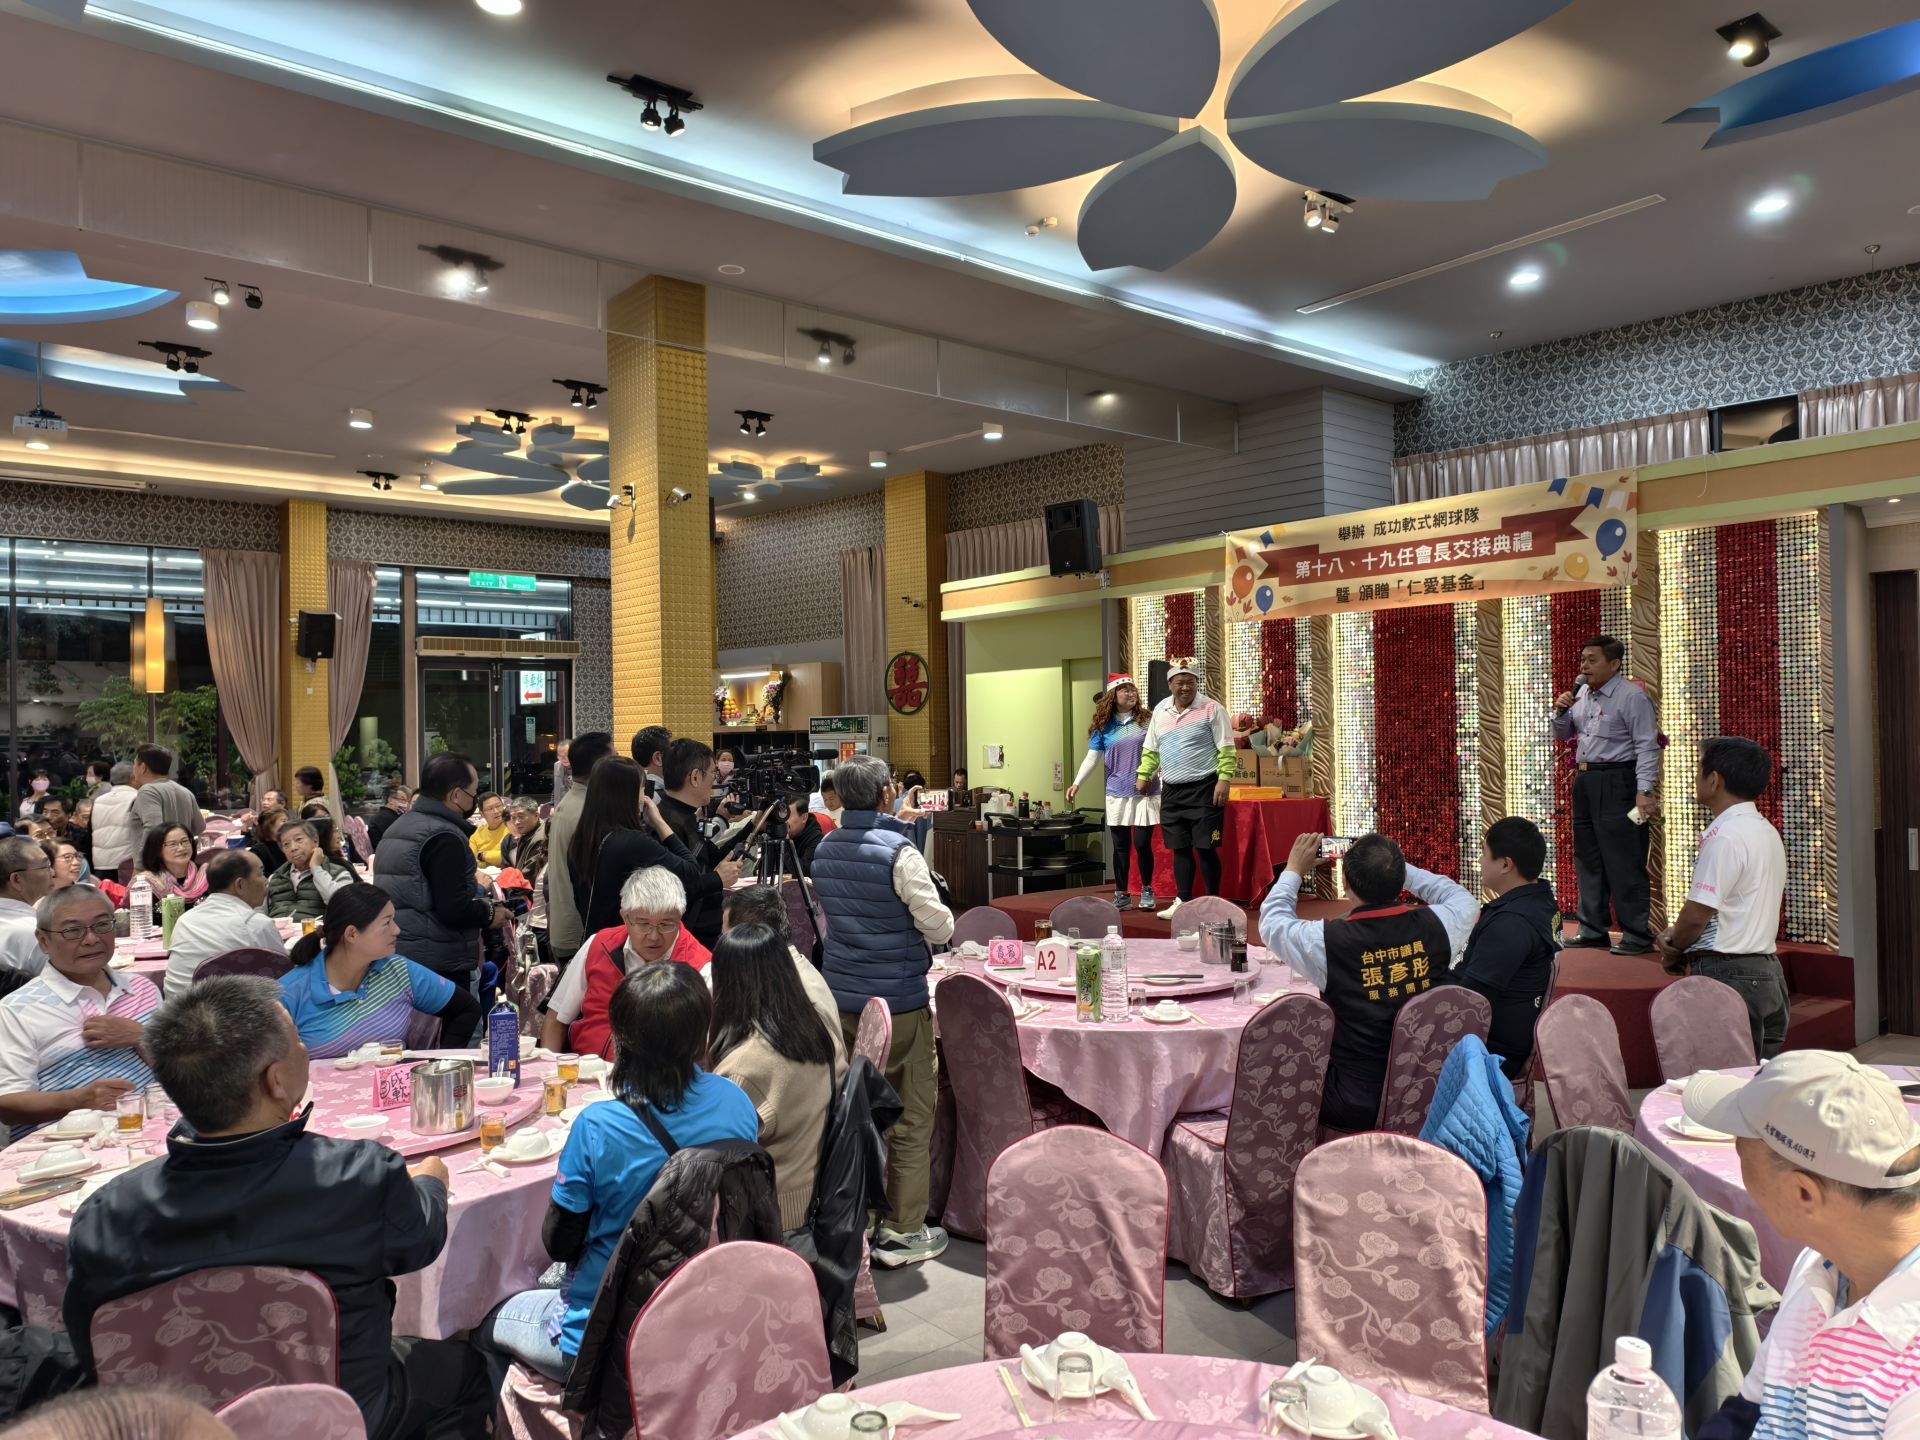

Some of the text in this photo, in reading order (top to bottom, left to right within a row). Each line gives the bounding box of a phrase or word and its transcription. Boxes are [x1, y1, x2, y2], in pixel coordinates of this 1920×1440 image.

[1338, 507, 1480, 541] 舉辦 成功軟式網球隊
[1295, 531, 1533, 579] 第十八、十九任會長交接典禮
[1336, 587, 1351, 604] 暨
[1037, 950, 1057, 971] A2
[1361, 940, 1425, 965] 台中市議員
[1361, 956, 1430, 987] 張彥彤
